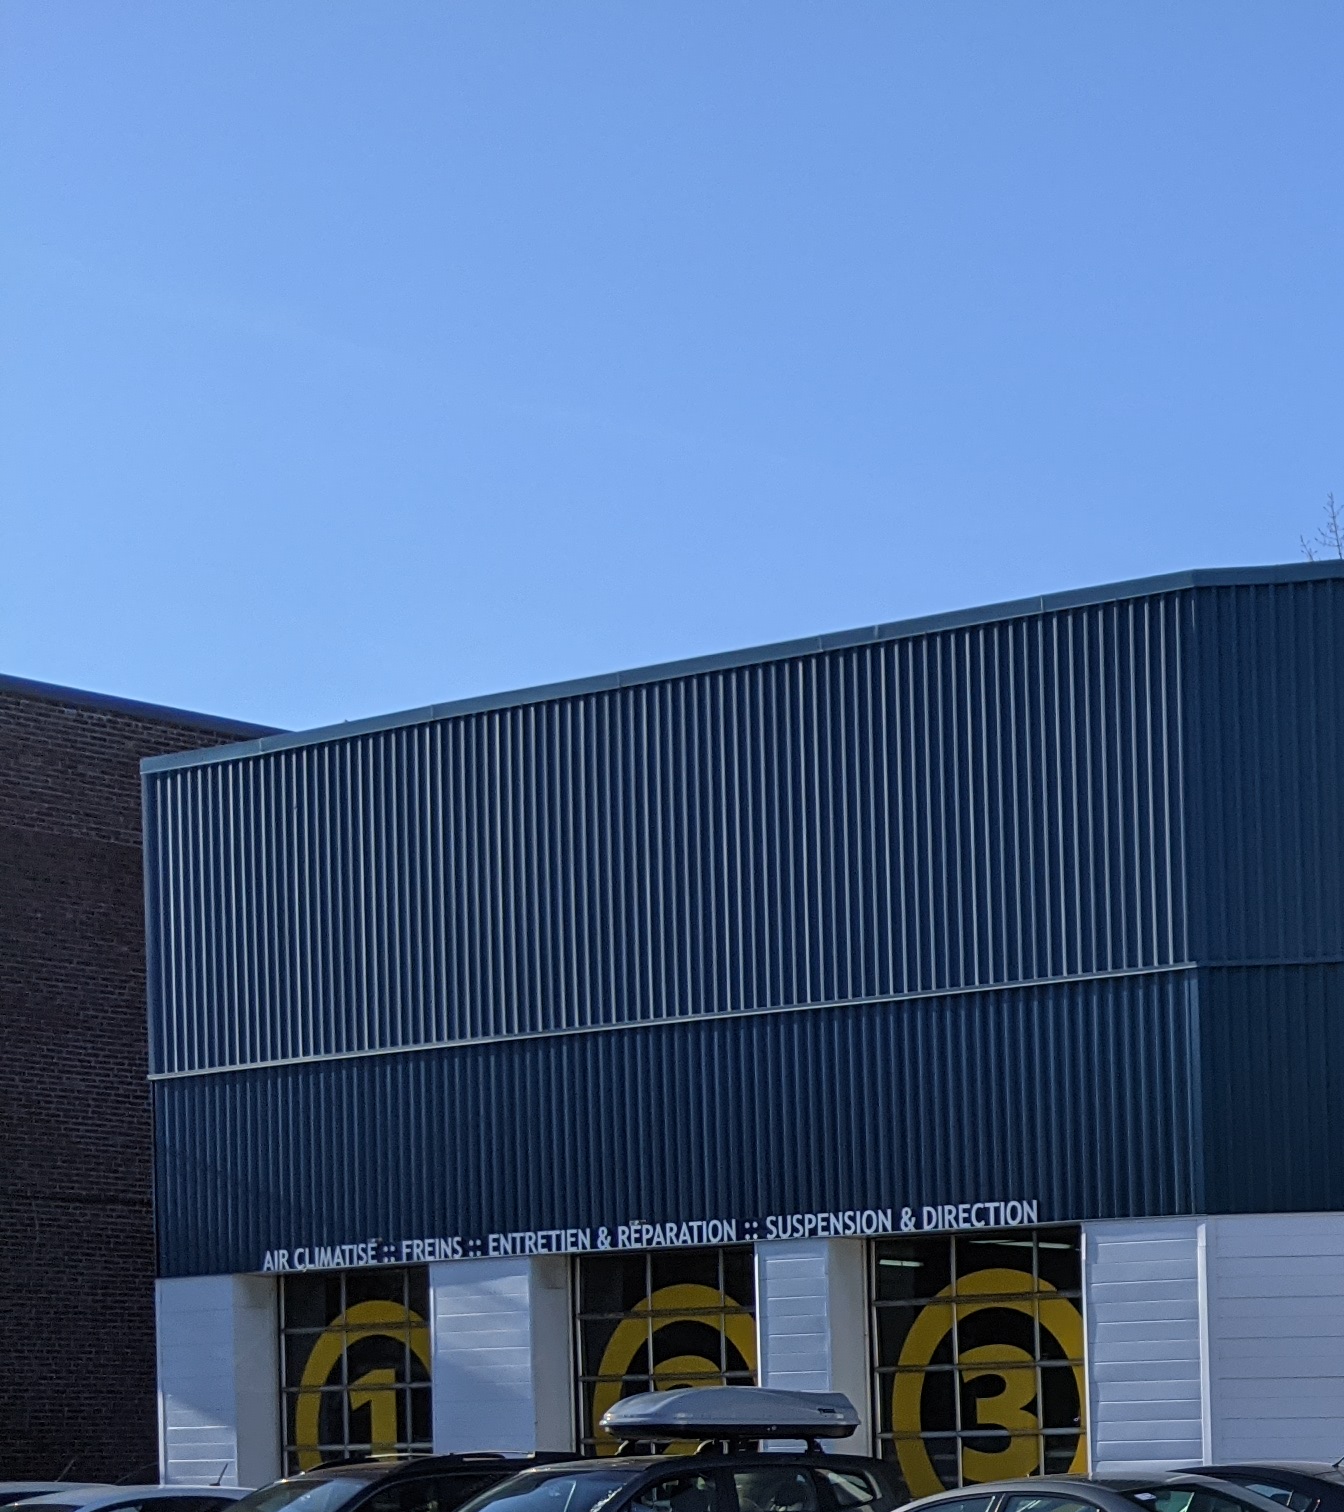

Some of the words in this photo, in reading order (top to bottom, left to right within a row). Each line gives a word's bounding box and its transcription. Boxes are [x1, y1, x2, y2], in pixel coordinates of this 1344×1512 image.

[263, 1250, 290, 1271] AIR
[402, 1236, 463, 1262] FREINS
[488, 1227, 591, 1257] ENTRETIEN
[597, 1226, 612, 1250] &
[617, 1219, 736, 1248] RÉPARATION
[766, 1208, 892, 1239] SUSPENSION
[900, 1206, 917, 1232] &
[923, 1199, 1038, 1230] DIRECTION
[956, 1343, 1039, 1483] 3
